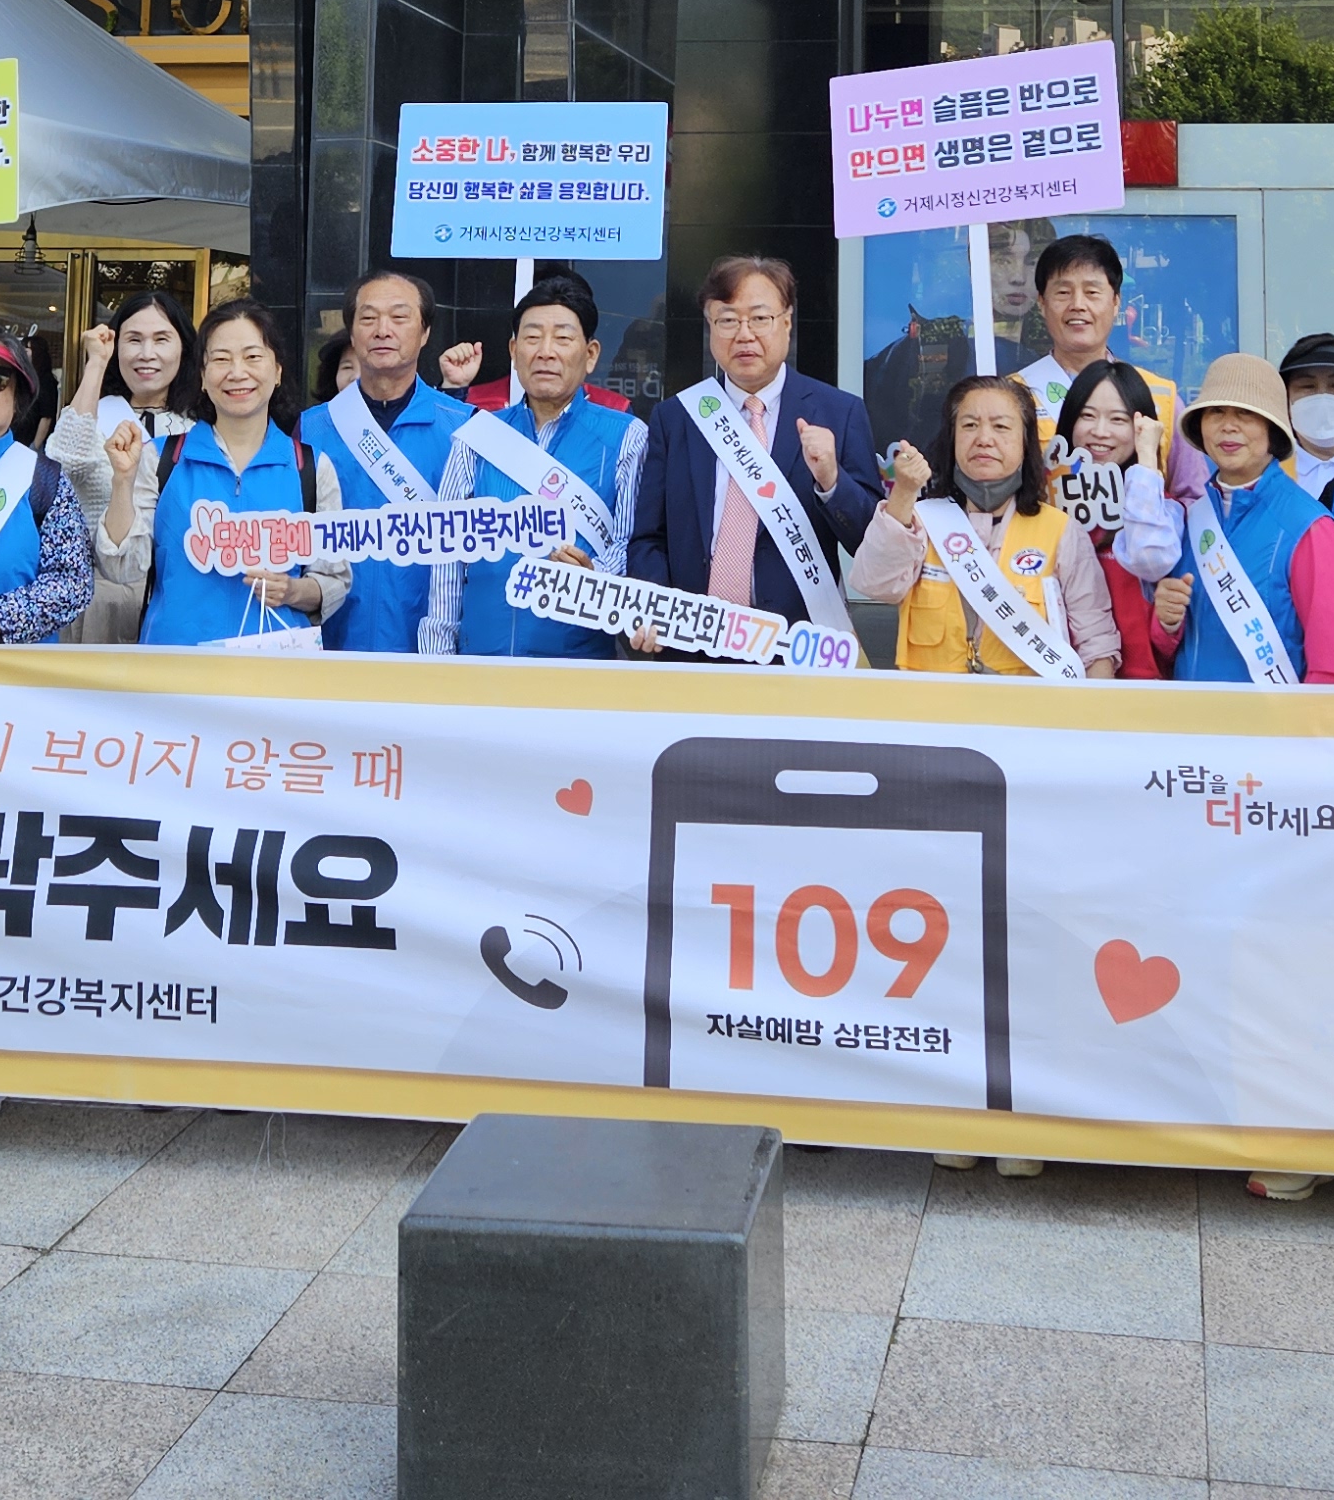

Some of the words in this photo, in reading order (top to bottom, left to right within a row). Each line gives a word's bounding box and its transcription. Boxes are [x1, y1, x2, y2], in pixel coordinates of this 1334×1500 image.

[849, 98, 924, 133] 나누면
[933, 87, 1010, 123] 슬픔은
[1019, 76, 1100, 113] 반으로
[412, 137, 480, 162] 소중한
[486, 138, 517, 163] 나,
[522, 143, 556, 162] 함께
[561, 143, 613, 162] 행복한
[617, 144, 652, 162] 우리
[850, 144, 926, 178] 안으면
[934, 133, 1012, 169] 생명은
[1022, 122, 1102, 158] 곁으로
[408, 181, 458, 201] 당신의
[464, 181, 514, 201] 행복한
[519, 181, 553, 201] 삶을
[558, 181, 650, 201] 응원합니다.
[904, 178, 1078, 213] 거제시정신건강복지센터
[459, 225, 621, 243] 거제시정신건강복지센터
[714, 415, 762, 481] 생명존중
[772, 503, 820, 585] 자살예방
[214, 521, 261, 568] 당신
[261, 518, 312, 565] 곁에
[314, 519, 383, 555] 거제시
[387, 504, 566, 557] 정신건강복지센터
[513, 563, 726, 648] #정신건강상담전화
[995, 600, 1015, 620] 때
[1027, 634, 1062, 665] 곁에
[32, 729, 202, 790] 보이지
[224, 737, 335, 795] 않을
[351, 743, 405, 801] 때
[1144, 765, 1228, 797] 사람을
[711, 883, 949, 999] 109
[706, 1014, 824, 1046] 자살예방
[834, 1023, 952, 1054] 상담전화
